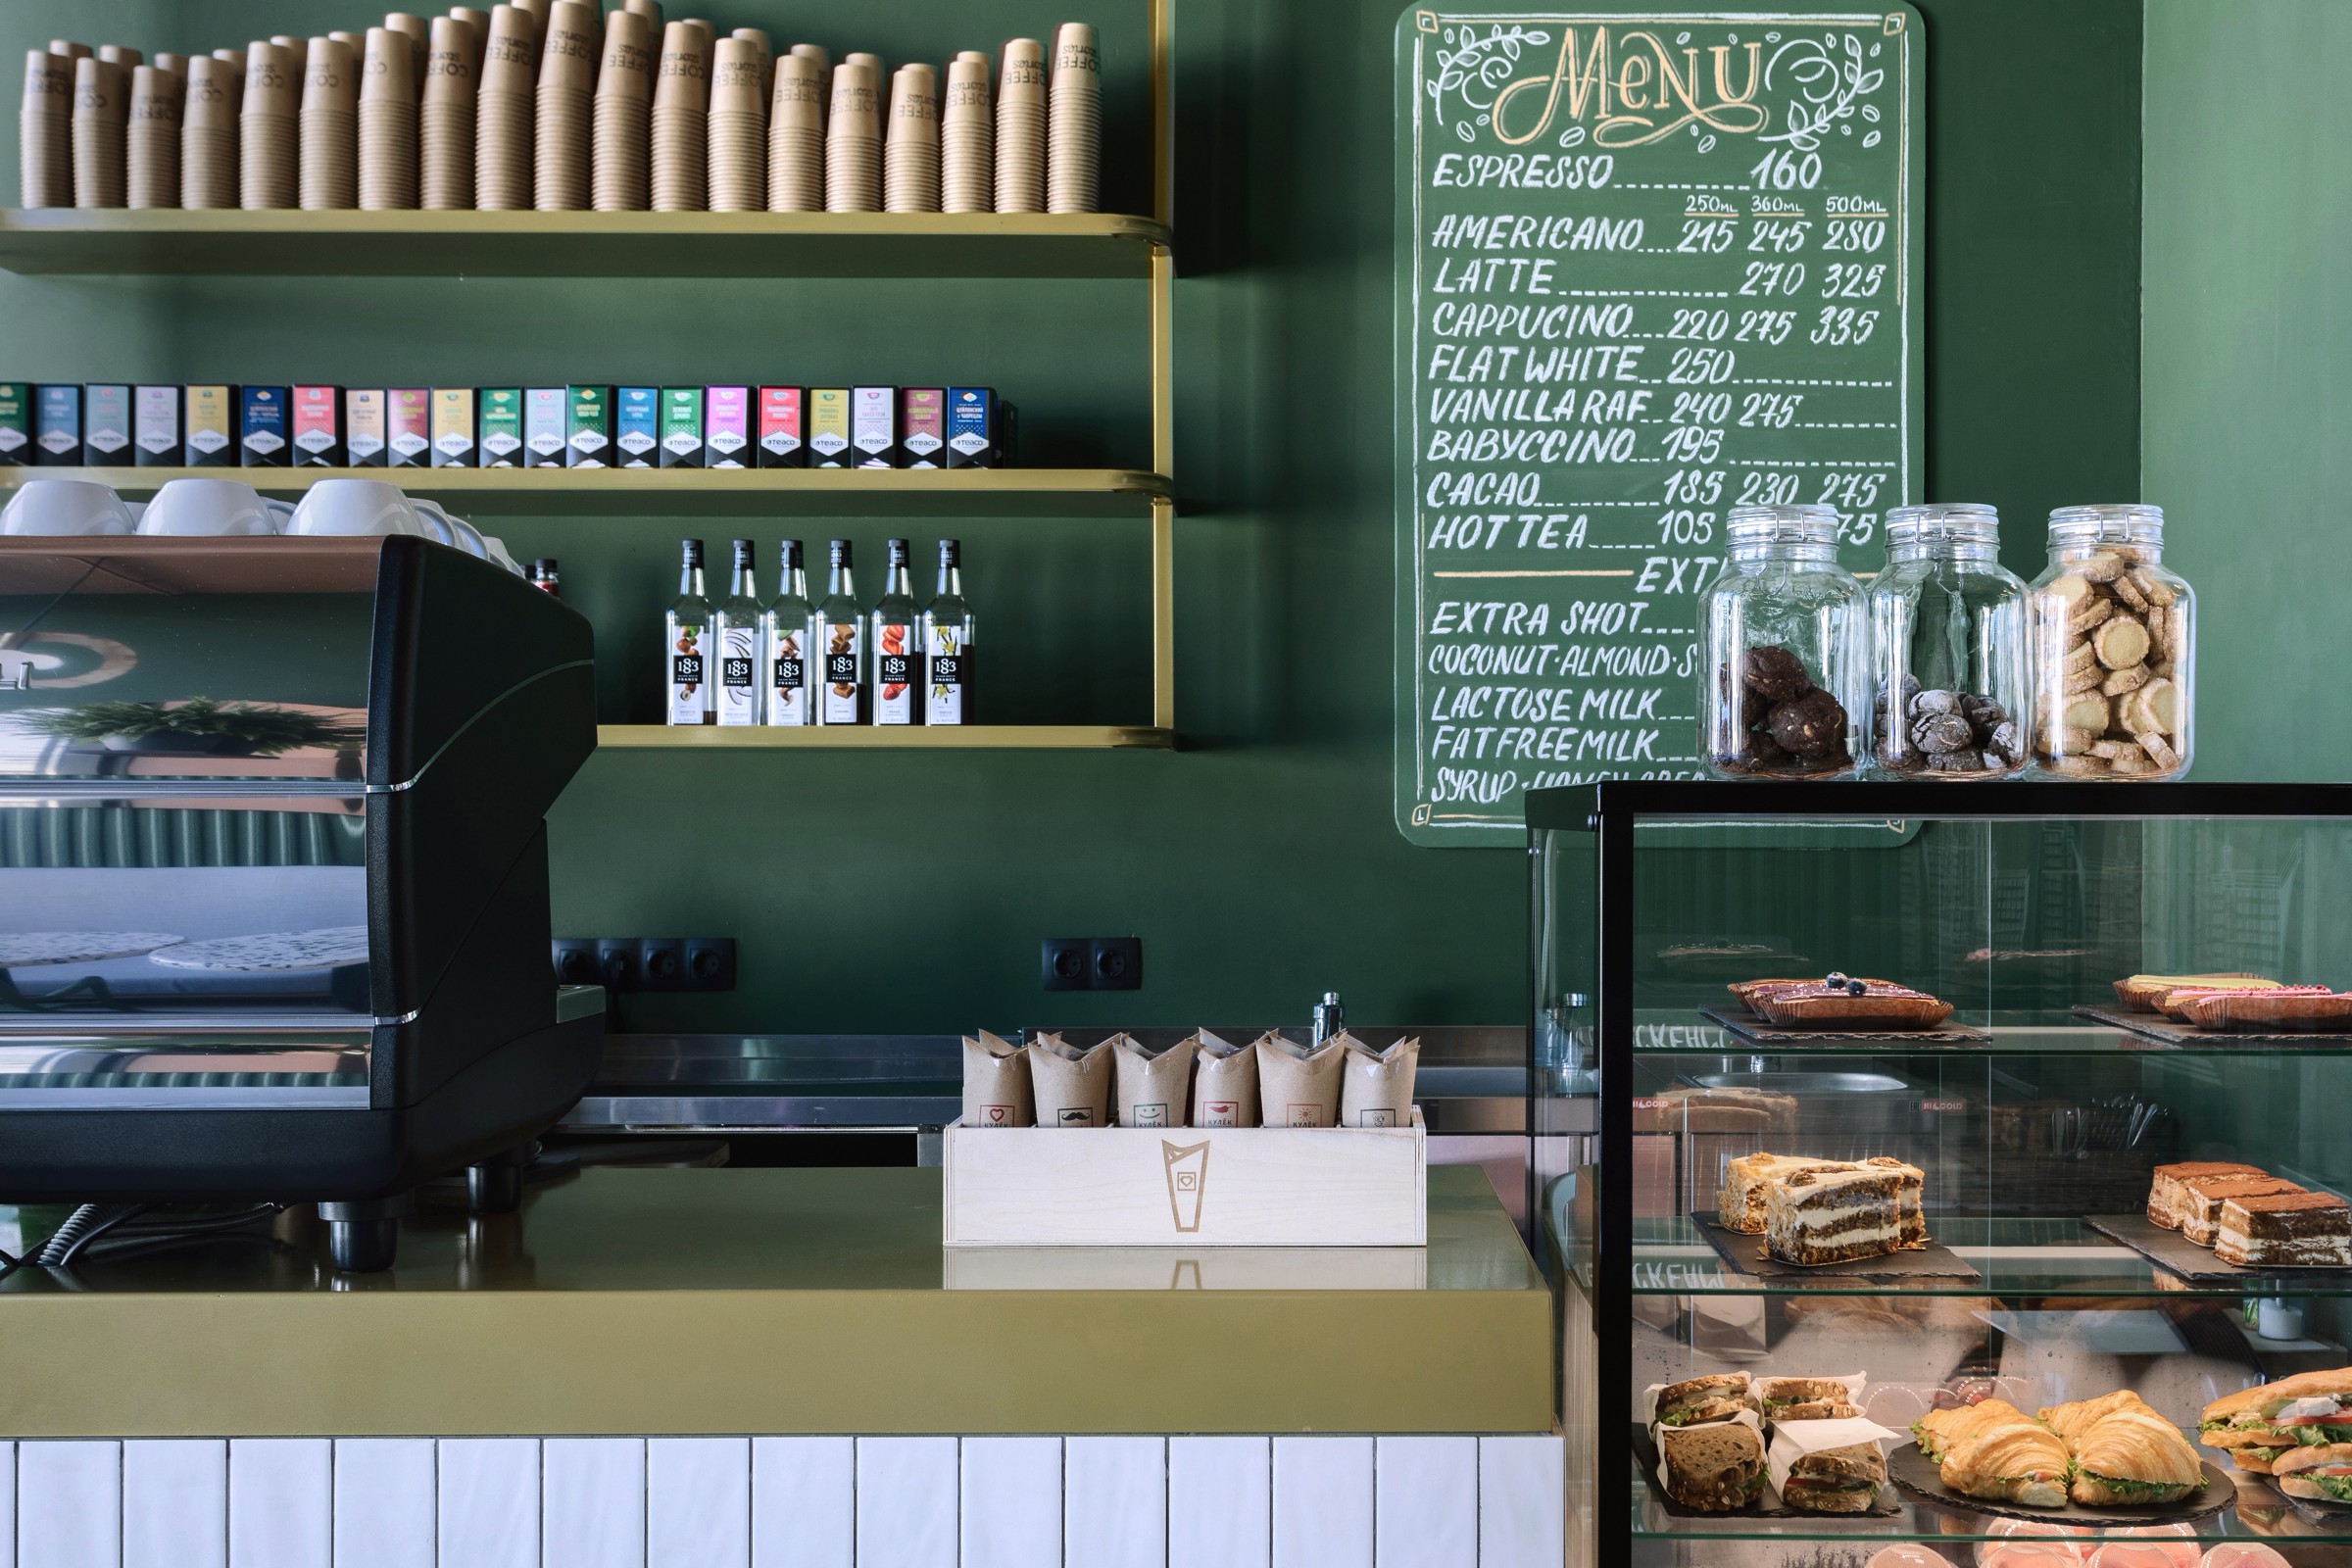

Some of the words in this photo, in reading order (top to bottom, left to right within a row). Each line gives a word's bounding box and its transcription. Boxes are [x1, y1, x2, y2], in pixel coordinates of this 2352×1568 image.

[1433, 154, 1613, 189] ESPRESSO
[1750, 148, 1822, 190] 160
[1686, 195, 1739, 212] 250ML
[1826, 195, 1886, 213] 500ML
[1432, 214, 1643, 251] AMERICANO
[1677, 220, 1738, 253] 215
[1747, 220, 1812, 252] 245
[1822, 220, 1885, 253] 280
[1433, 258, 1556, 294] LATTE
[1738, 262, 1804, 296] 270
[1822, 263, 1886, 298] 325
[1433, 302, 1633, 339] CAPPUCINO
[1667, 309, 1729, 341] 220
[1735, 310, 1796, 345] 275
[1810, 306, 1880, 345] 335
[1429, 344, 1519, 382] FLAT
[1524, 345, 1644, 383] WHITE
[1666, 347, 1735, 384] 250
[1431, 388, 1576, 424] VANILLA
[1581, 390, 1652, 424] RAF
[1669, 392, 1732, 423] 240
[1739, 393, 1803, 428] 275
[1427, 428, 1636, 464] BABYCCINO
[1662, 426, 1725, 464] 195
[1427, 472, 1540, 508] CACAO
[1664, 469, 1726, 505] 185
[1735, 471, 1803, 509] 230
[1813, 472, 1886, 512] 275
[1429, 514, 1517, 550] HOT
[1518, 514, 1587, 549] TEA
[1658, 510, 1716, 544] 105
[1838, 510, 1877, 546] 75
[1635, 557, 1728, 594] EXT
[1430, 602, 1548, 636] EXTRA
[1561, 601, 1648, 635] SHOT
[1432, 686, 1573, 723] LACTOSE
[1579, 689, 1661, 720] MILK
[1432, 725, 1497, 759] FAT
[1495, 727, 1579, 760] FREE
[1577, 729, 1659, 761] MILK
[1431, 767, 1516, 804] SYRUP
